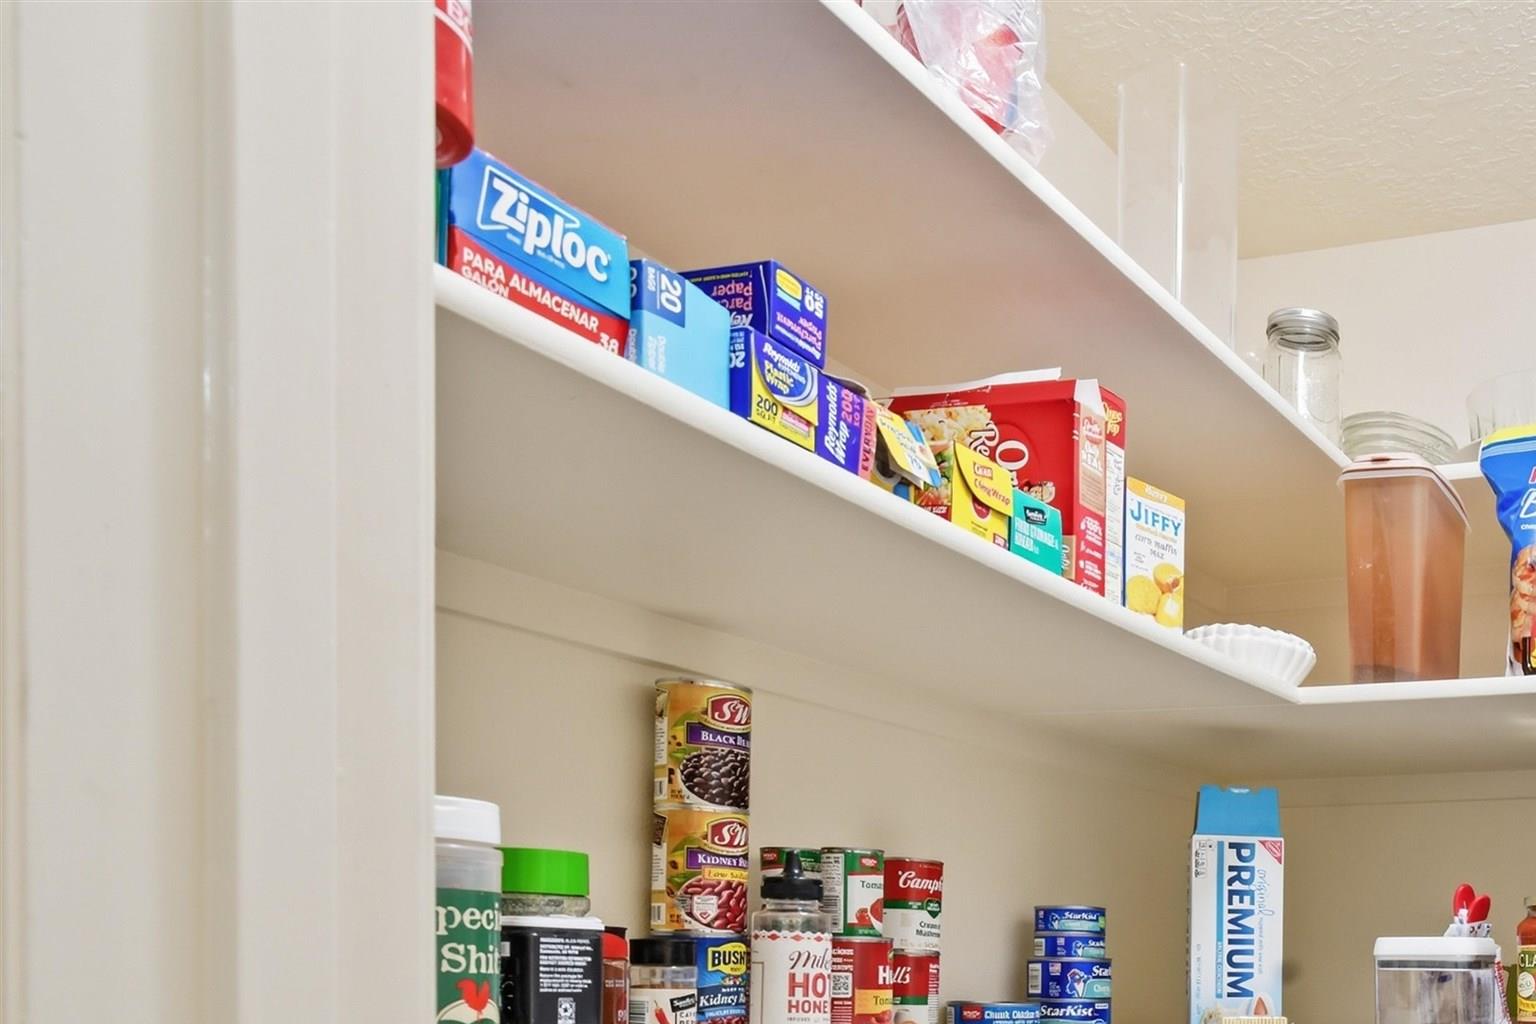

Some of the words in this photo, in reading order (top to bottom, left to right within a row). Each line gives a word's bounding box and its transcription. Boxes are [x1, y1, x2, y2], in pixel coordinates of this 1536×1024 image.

[491, 178, 609, 283] Ziploc
[463, 246, 505, 282] PARA
[509, 273, 599, 332] ALMACENAR
[660, 273, 683, 314] 20
[711, 281, 753, 298] Paper
[803, 294, 824, 320] 50
[599, 332, 620, 355] 38
[756, 394, 778, 416] 200
[841, 387, 852, 421] 200
[824, 381, 838, 453] Reynolds
[832, 421, 850, 465] Wrap
[1129, 500, 1182, 537] JIFFY
[1135, 534, 1152, 545] corn
[701, 730, 736, 746] BLACK
[697, 853, 739, 867] KIDNEY
[435, 903, 501, 936] peci
[1226, 842, 1256, 998] PREMIUM
[788, 947, 830, 971] Mik
[699, 993, 738, 1007] Kidney
[787, 999, 829, 1014] HONE
[1040, 1005, 1094, 1017] StarKist
